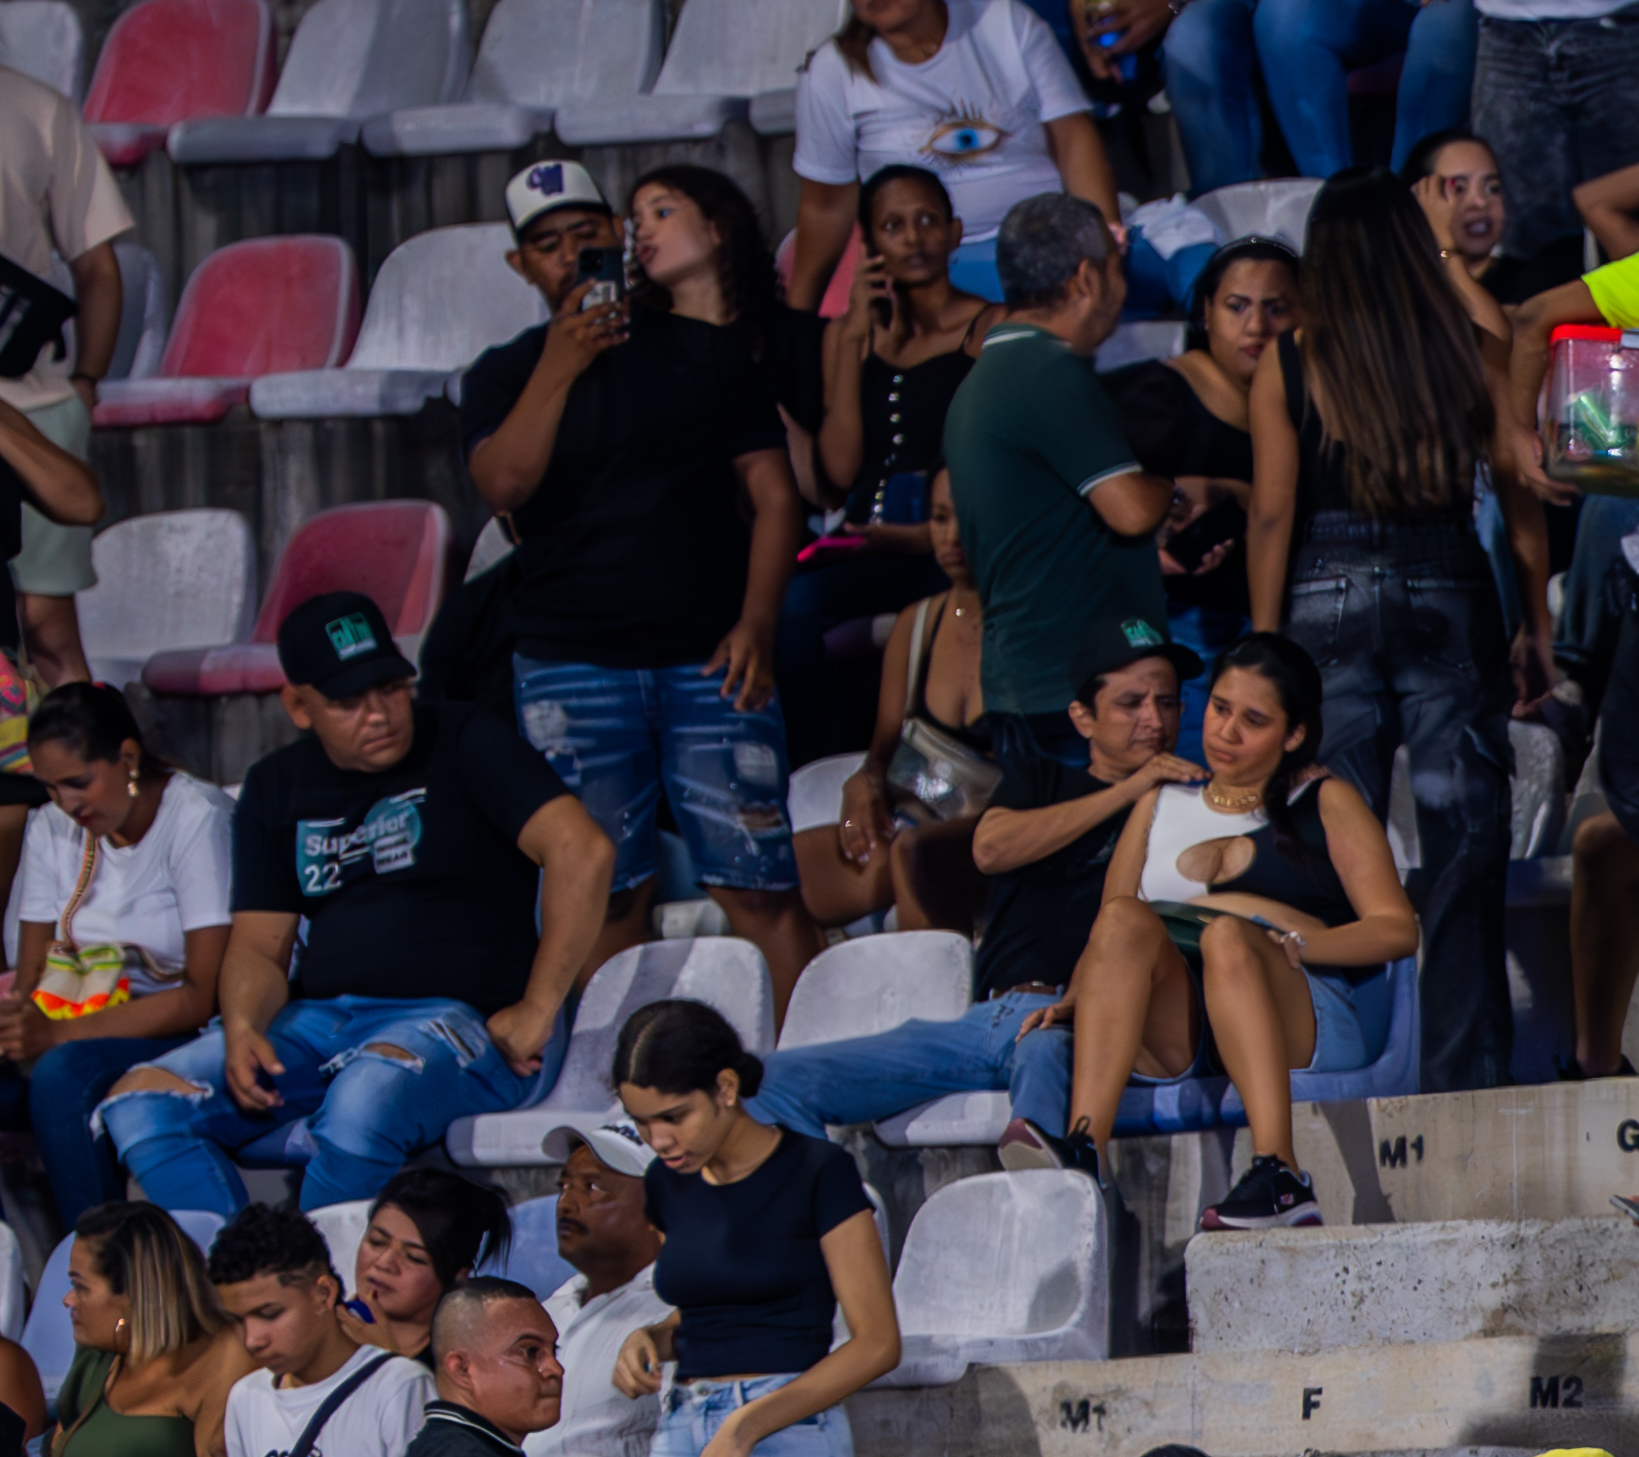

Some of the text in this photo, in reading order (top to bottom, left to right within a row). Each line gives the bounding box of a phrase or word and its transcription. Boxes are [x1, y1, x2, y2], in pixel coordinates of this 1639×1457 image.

[303, 859, 344, 893] 22
[1379, 1133, 1425, 1169] M1
[1301, 1387, 1323, 1420] F
[1529, 1374, 1585, 1409] M2
